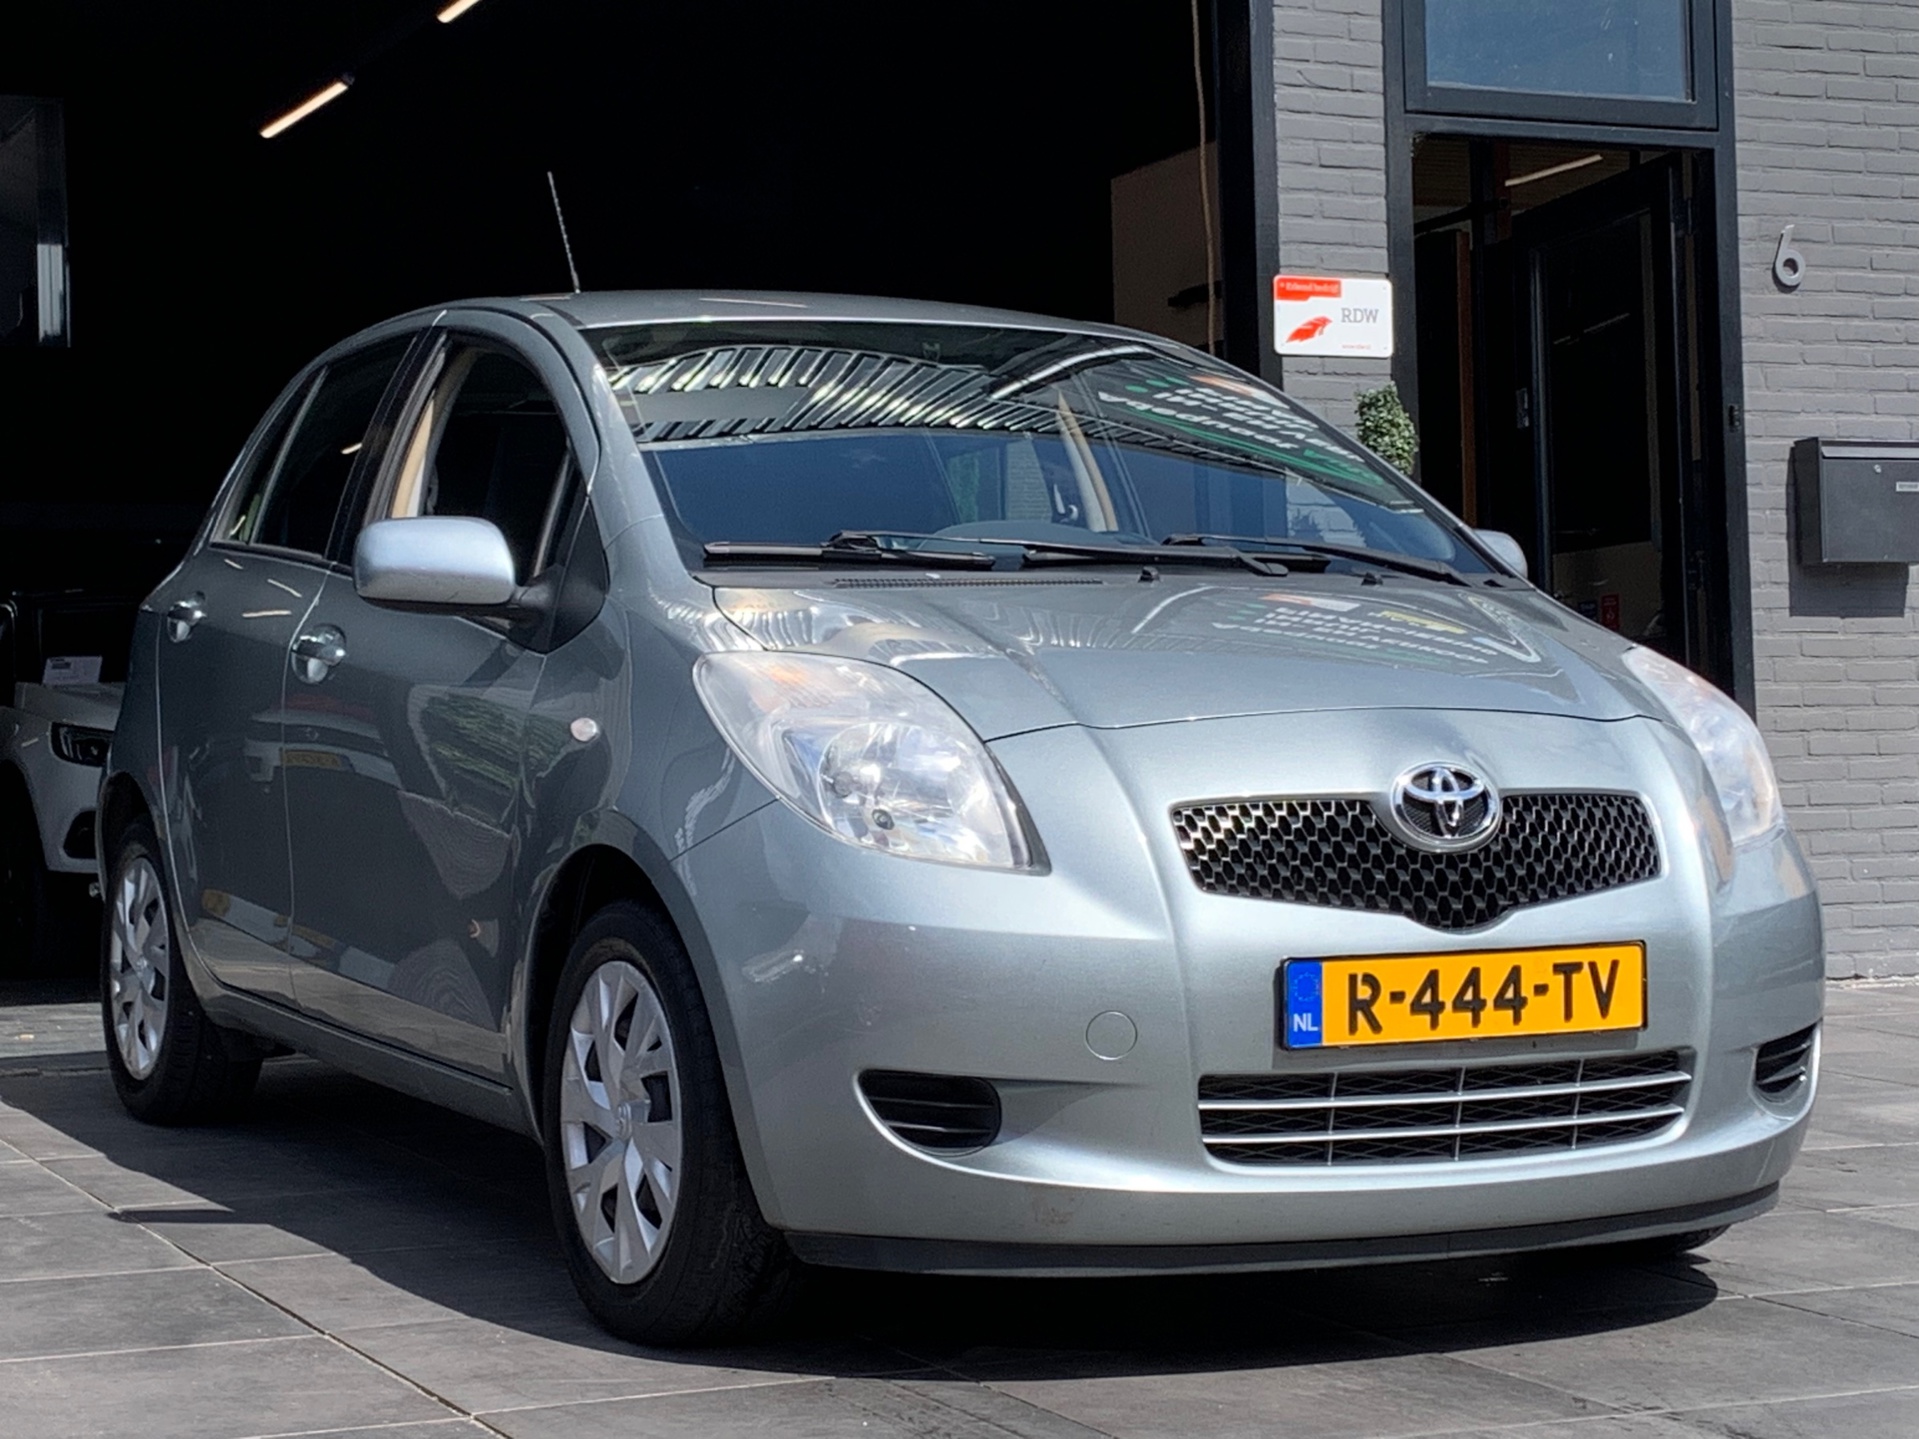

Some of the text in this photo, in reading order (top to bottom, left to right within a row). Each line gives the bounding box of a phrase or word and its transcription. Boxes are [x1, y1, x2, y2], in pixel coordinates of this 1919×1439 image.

[1774, 224, 1806, 287] 6
[1341, 307, 1379, 324] RDW
[1347, 959, 1620, 1036] R-444-TV
[1293, 1013, 1319, 1031] NL
